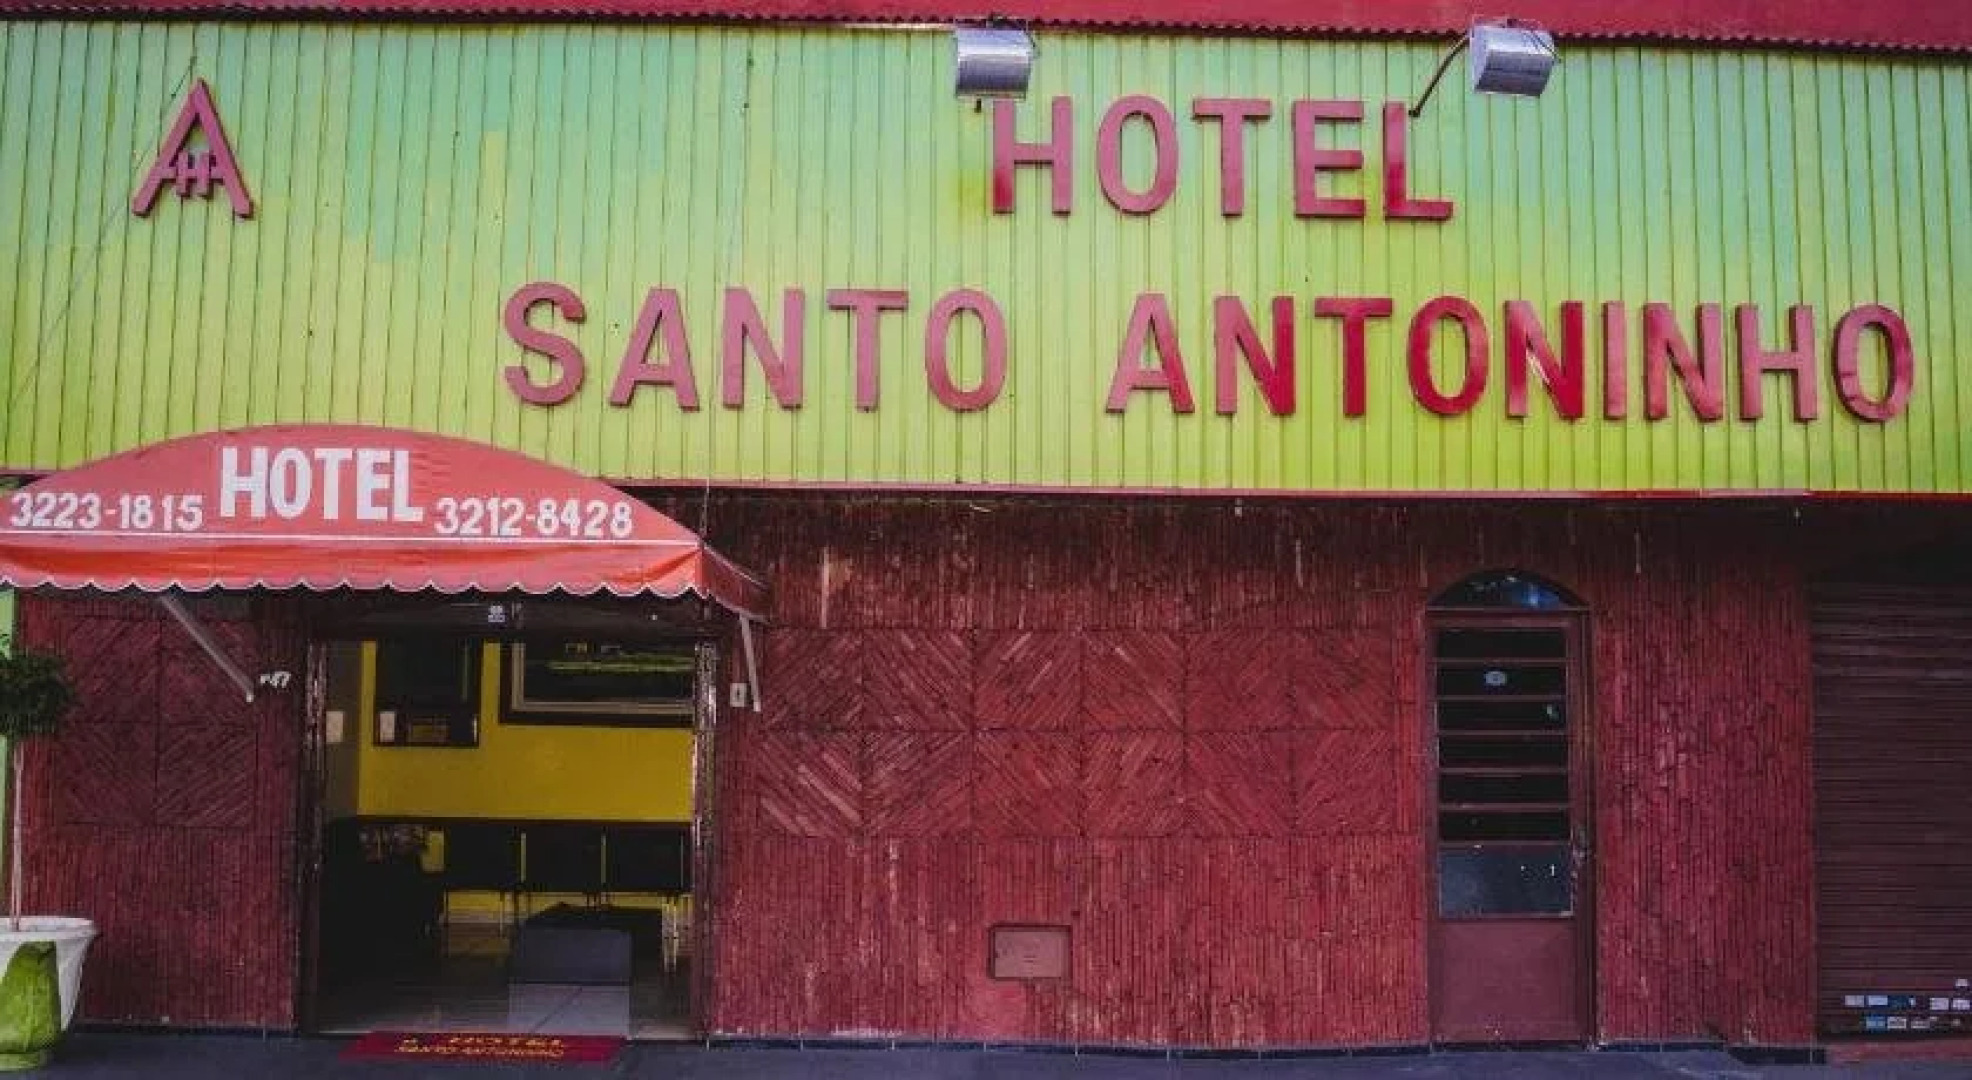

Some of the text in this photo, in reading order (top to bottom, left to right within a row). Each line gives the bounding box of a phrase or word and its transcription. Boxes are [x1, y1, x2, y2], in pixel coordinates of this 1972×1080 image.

[992, 94, 1454, 220] HOTEL
[503, 281, 1915, 422] SANTO ANTONINHO
[10, 446, 633, 538] 3223-1815 HOTEL 3212-8428
